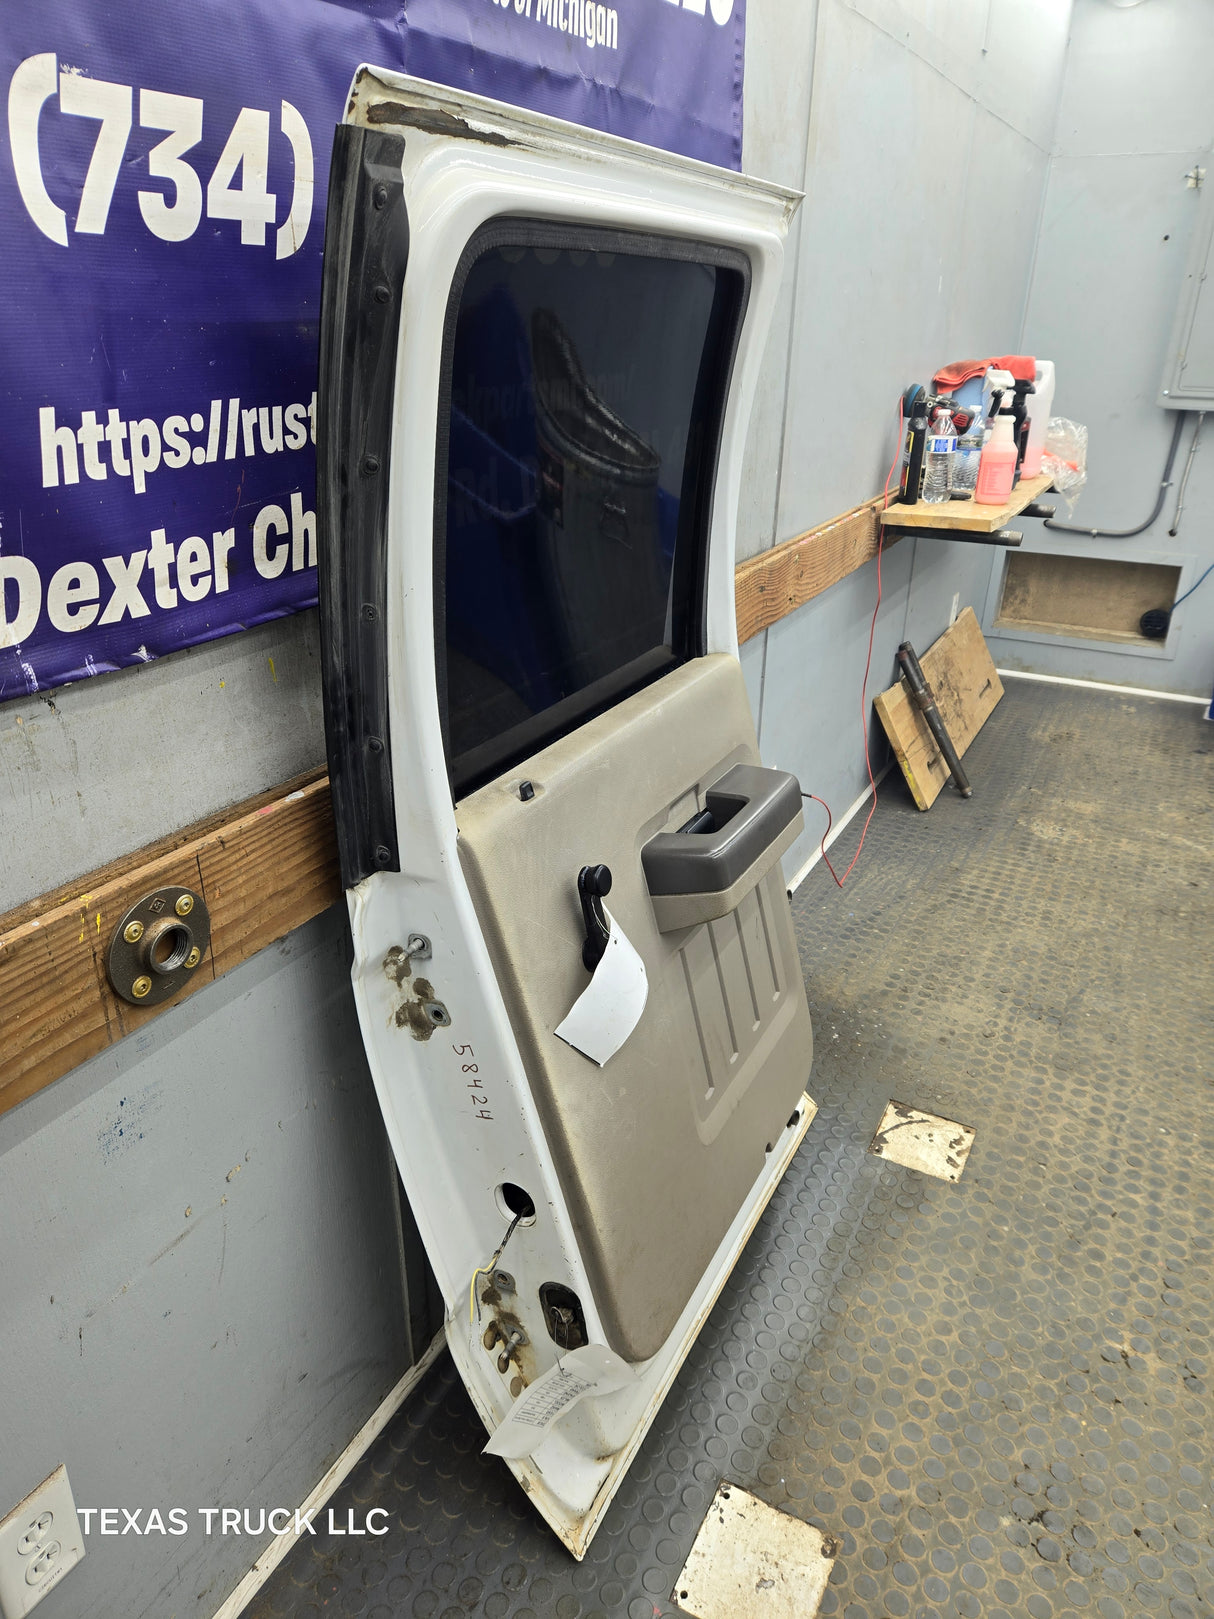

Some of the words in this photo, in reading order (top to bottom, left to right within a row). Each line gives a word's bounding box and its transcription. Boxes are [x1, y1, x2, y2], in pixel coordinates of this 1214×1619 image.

[535, 0, 618, 49] Michigan
[9, 53, 314, 260] (734)
[0, 527, 236, 649] Dexter
[452, 1044, 494, 1120] 58424
